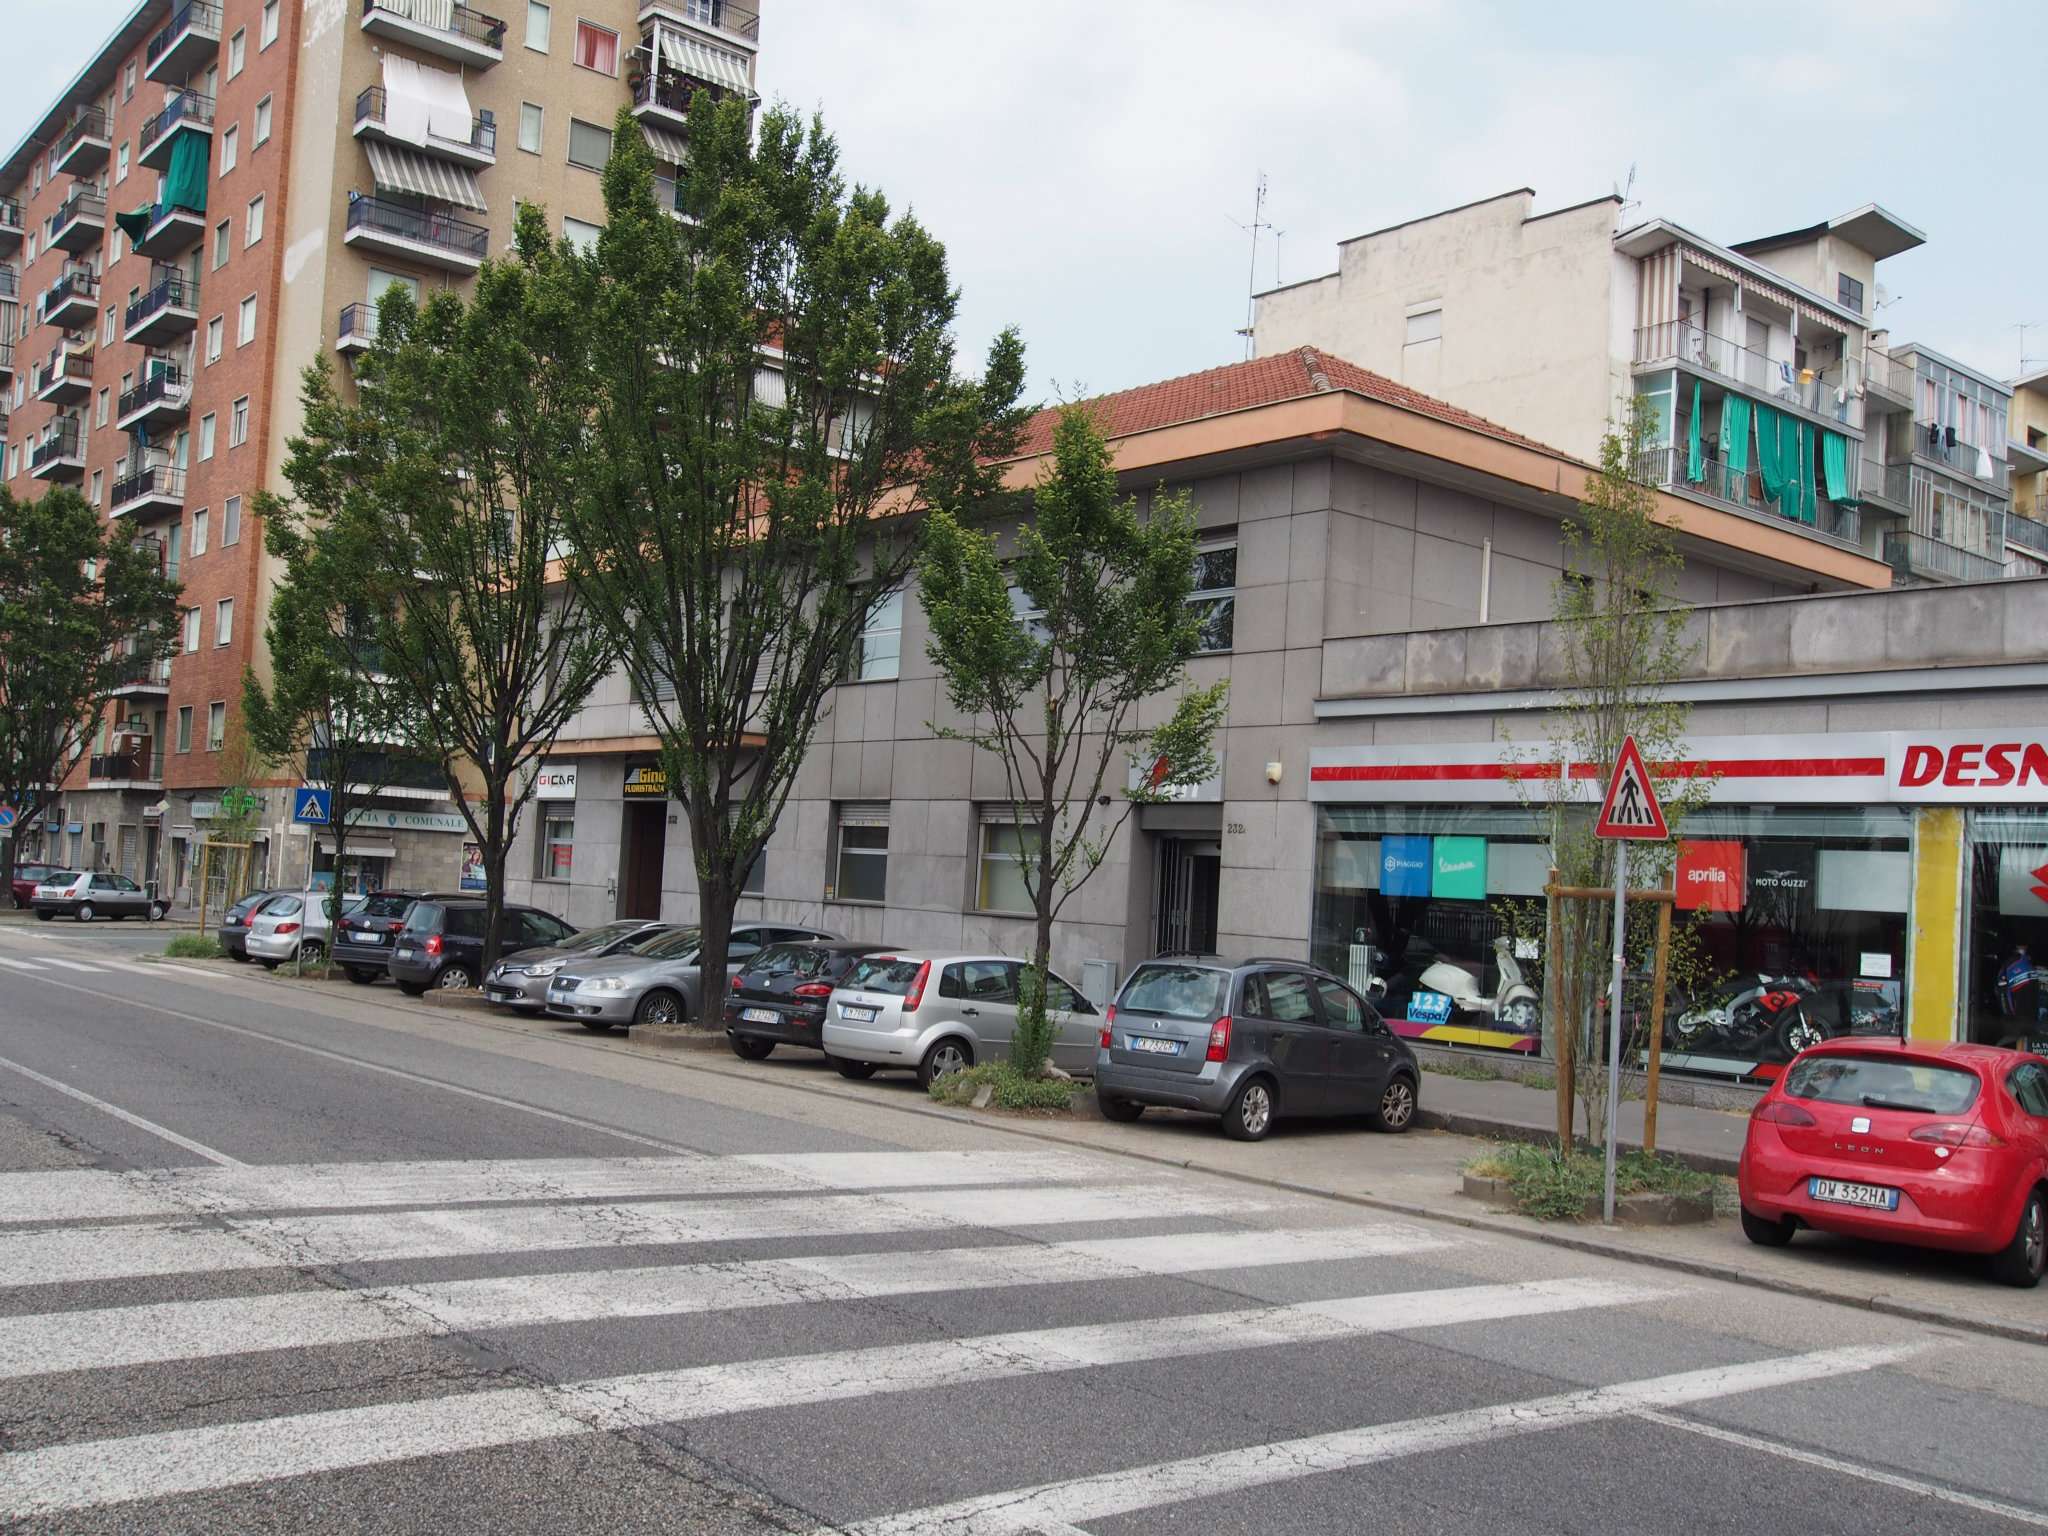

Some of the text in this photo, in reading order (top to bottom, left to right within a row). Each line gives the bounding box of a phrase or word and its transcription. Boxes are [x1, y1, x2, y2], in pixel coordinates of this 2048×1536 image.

[405, 815, 464, 828] COMUNALE
[1396, 861, 1424, 869] PIAGGIO
[1687, 867, 1726, 883] aprilia
[1755, 878, 1808, 888] MOTO GUZZI
[1409, 1006, 1452, 1022] Vespa!
[1834, 1142, 1884, 1154] LEON
[1818, 1181, 1837, 1197] DW
[1841, 1184, 1887, 1205] 332HA
